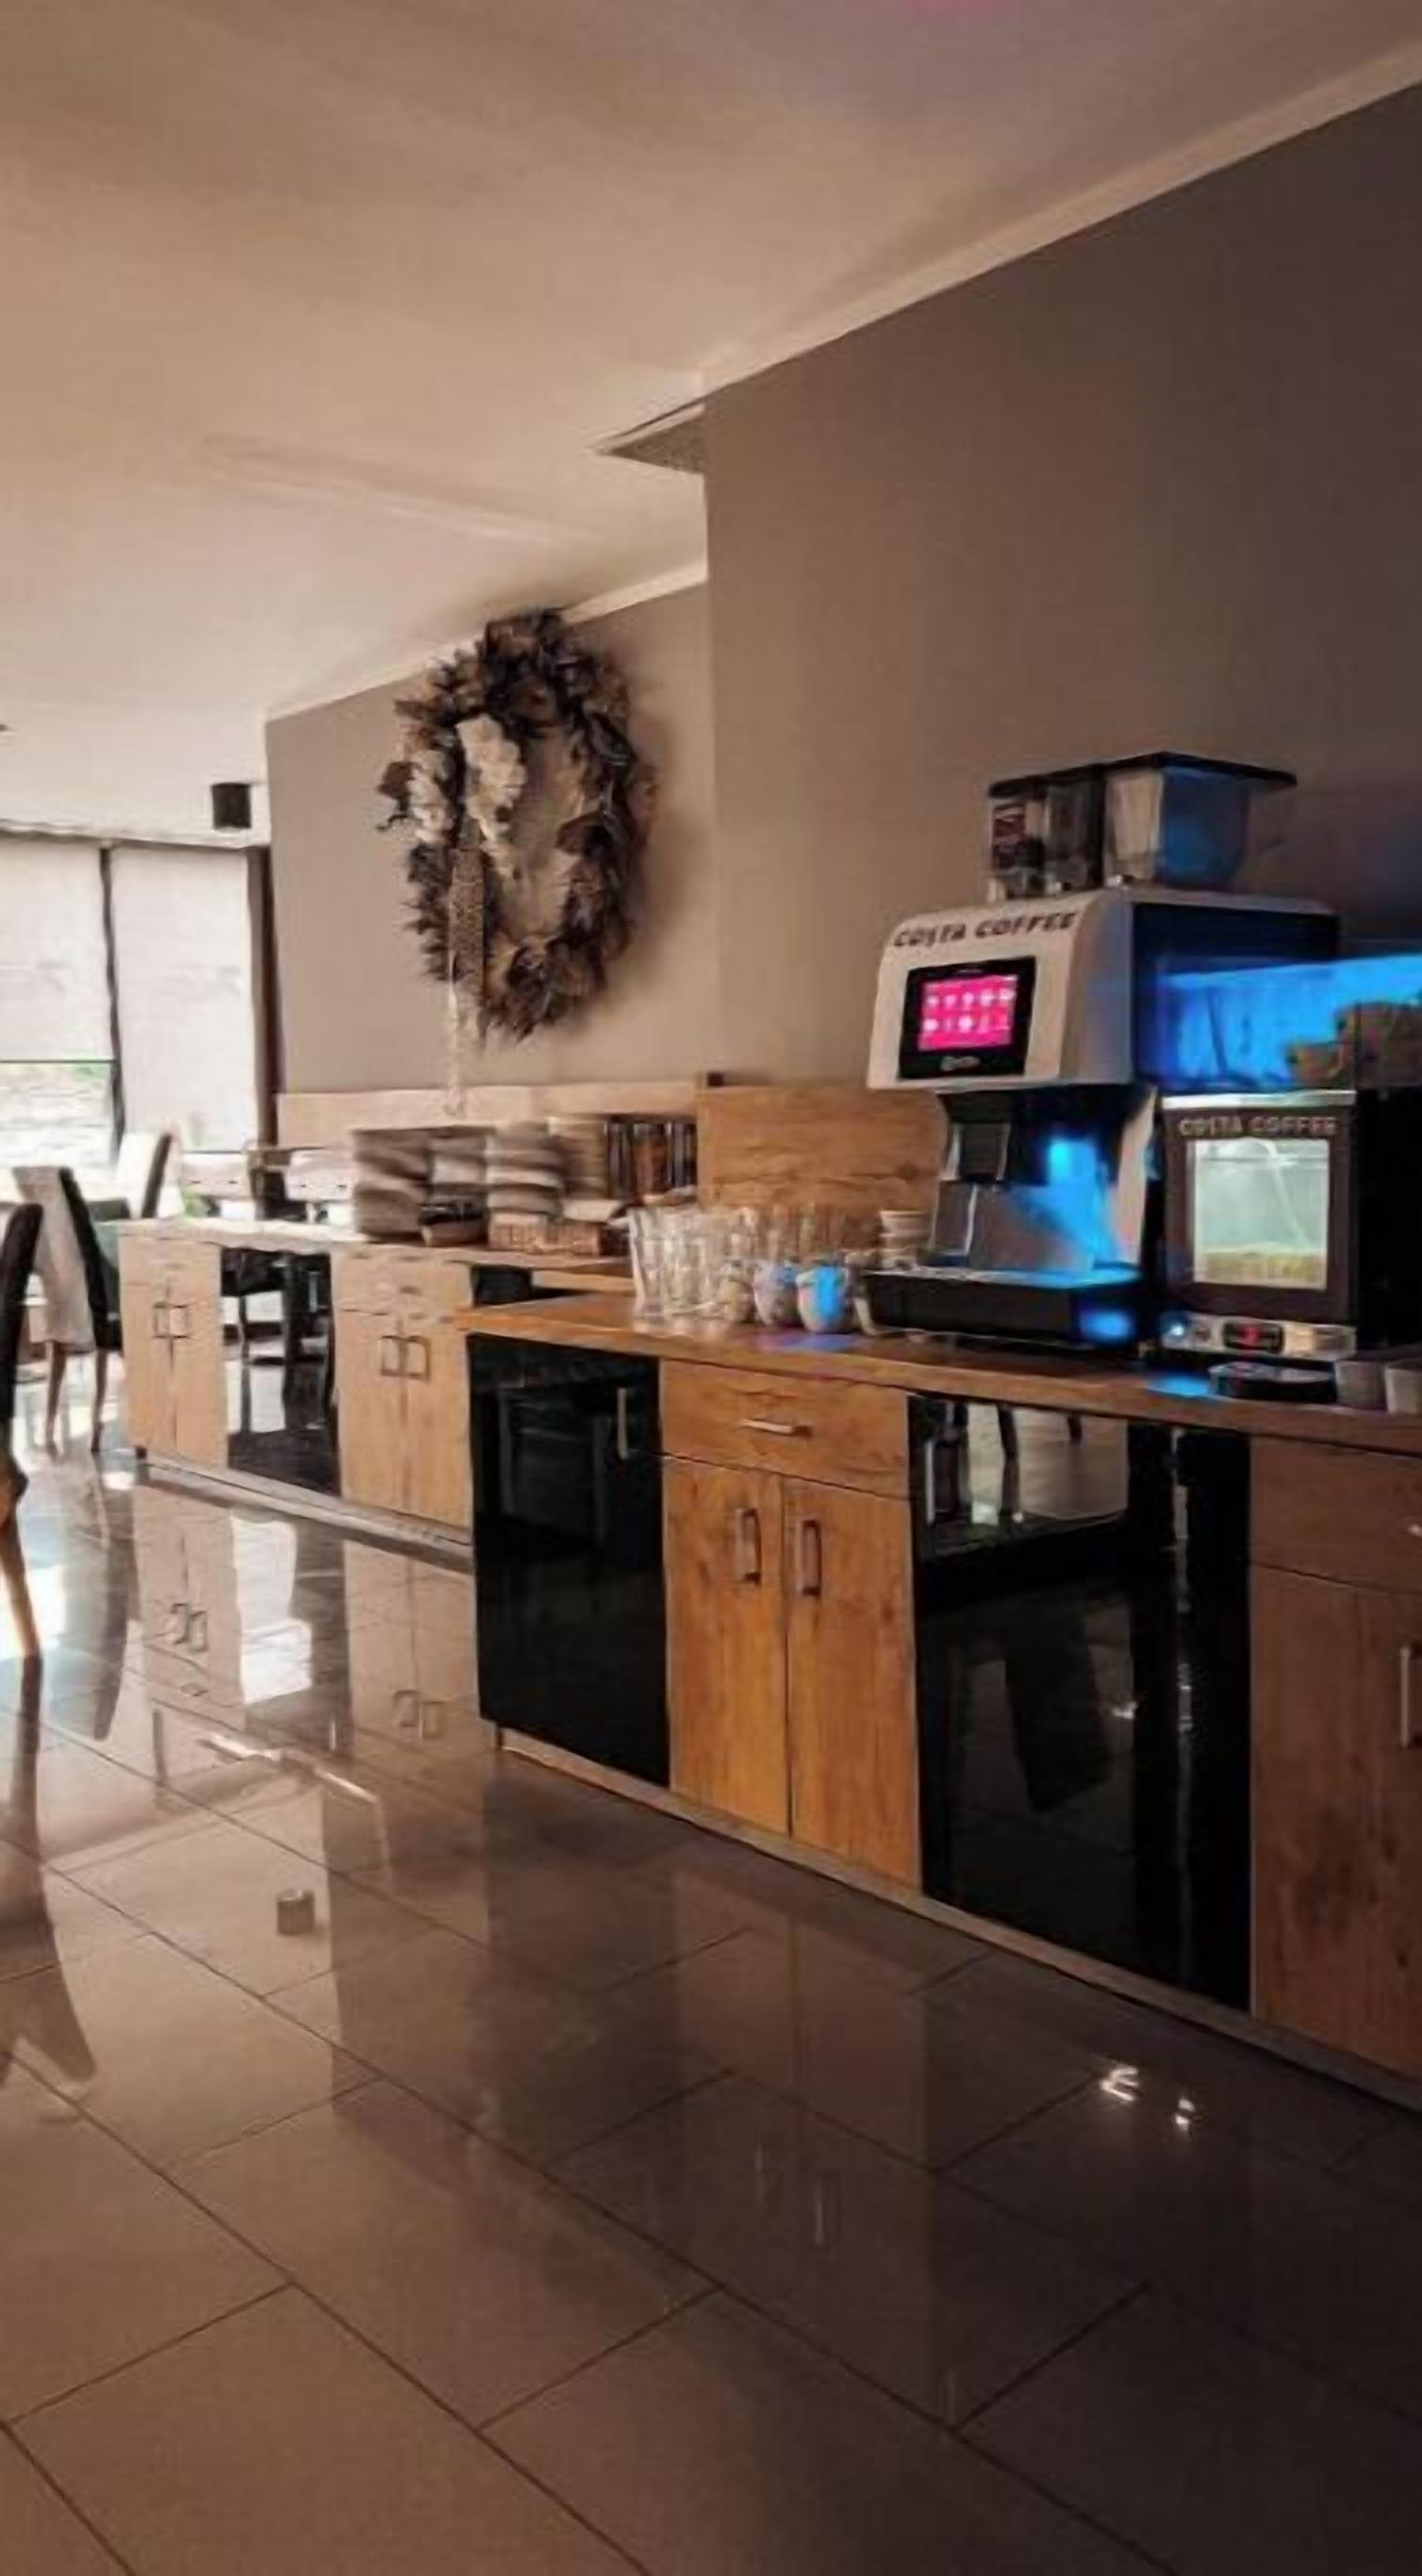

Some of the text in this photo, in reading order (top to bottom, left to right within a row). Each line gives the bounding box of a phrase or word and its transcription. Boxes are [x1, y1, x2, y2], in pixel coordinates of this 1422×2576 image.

[894, 912, 1076, 947] COSTA COFFEE
[1180, 1115, 1337, 1137] COSTA COFFEE
